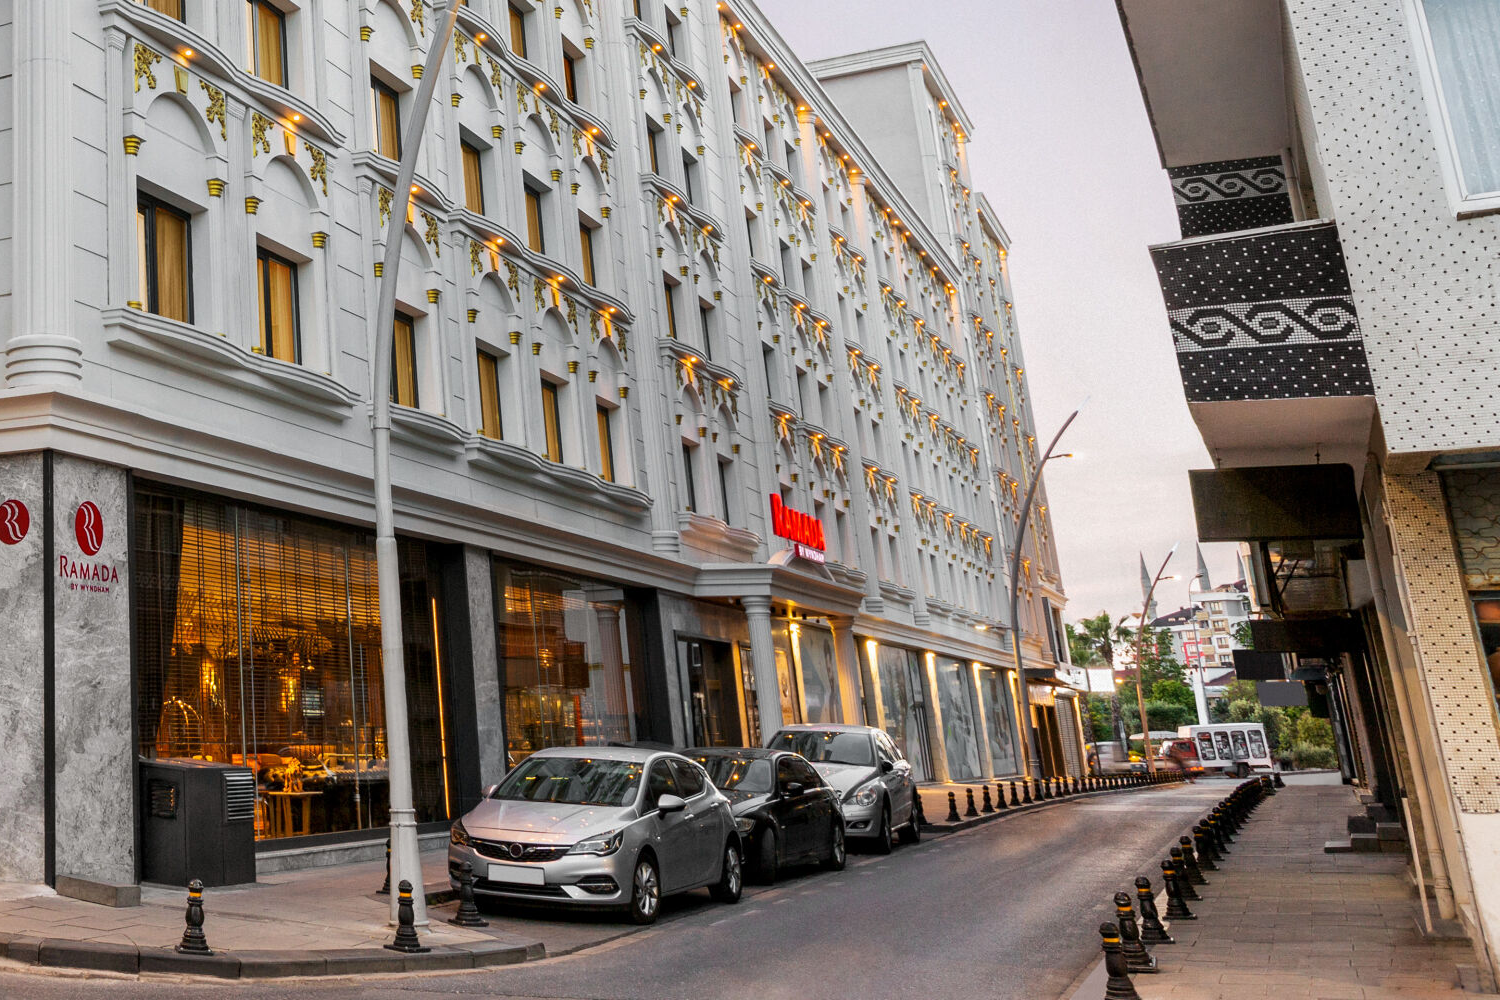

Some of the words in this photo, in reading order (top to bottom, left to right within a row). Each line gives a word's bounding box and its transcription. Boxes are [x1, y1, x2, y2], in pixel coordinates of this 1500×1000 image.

[769, 493, 827, 551] RAMADA
[59, 555, 119, 583] RAMADA
[80, 584, 110, 593] WYNDHAM
